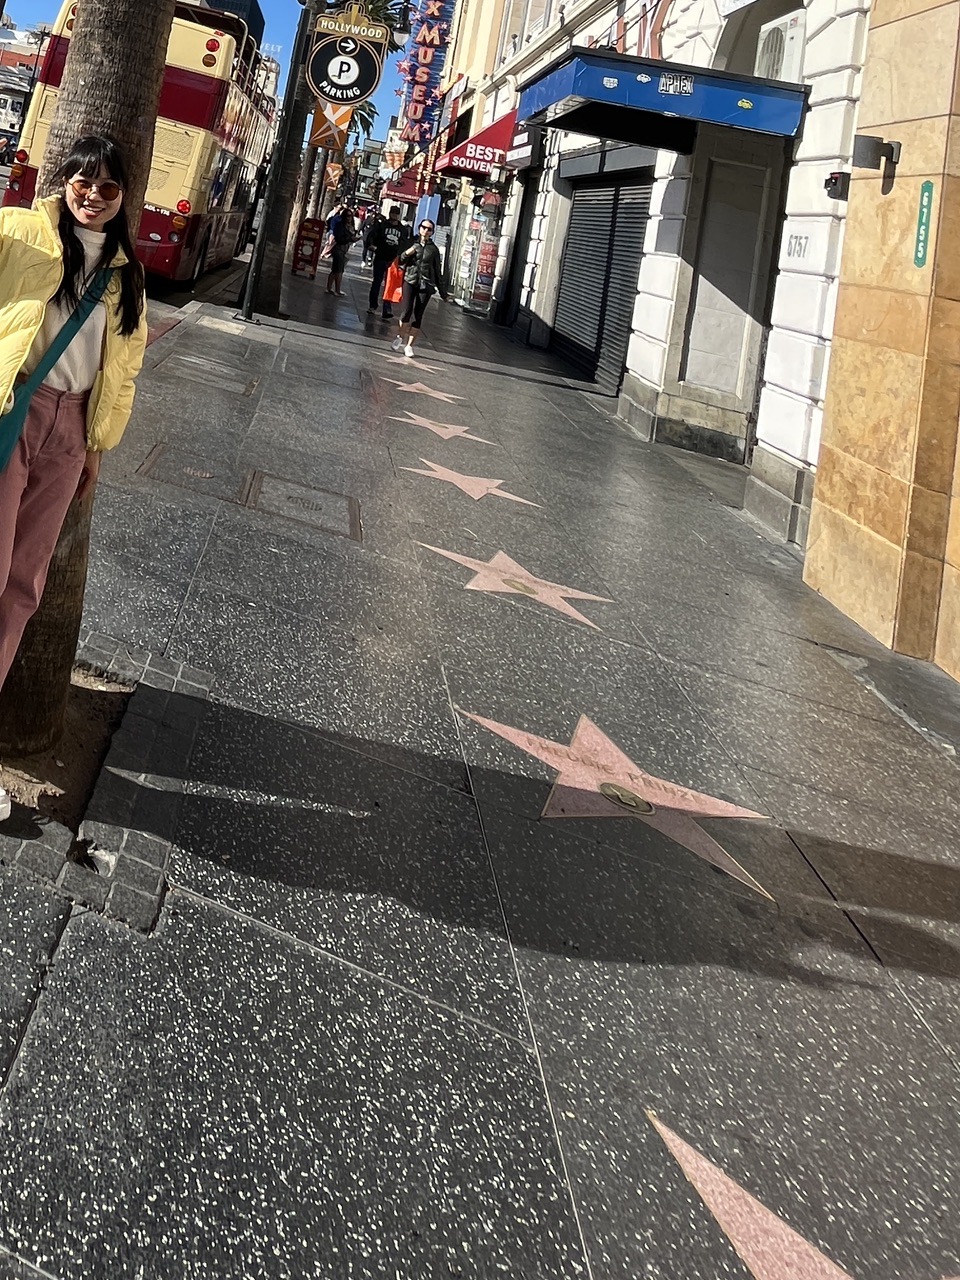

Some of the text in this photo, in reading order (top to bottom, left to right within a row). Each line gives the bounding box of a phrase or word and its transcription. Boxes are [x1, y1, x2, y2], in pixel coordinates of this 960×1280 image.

[320, 19, 382, 39] HOLLYWOOD
[339, 60, 351, 80] P
[319, 80, 361, 99] PARKING
[400, 22, 441, 143] MUSEUM
[658, 73, 694, 95] APHEX
[465, 143, 502, 163] BEST
[452, 156, 494, 173] SOUVEN
[787, 234, 809, 258] 6757
